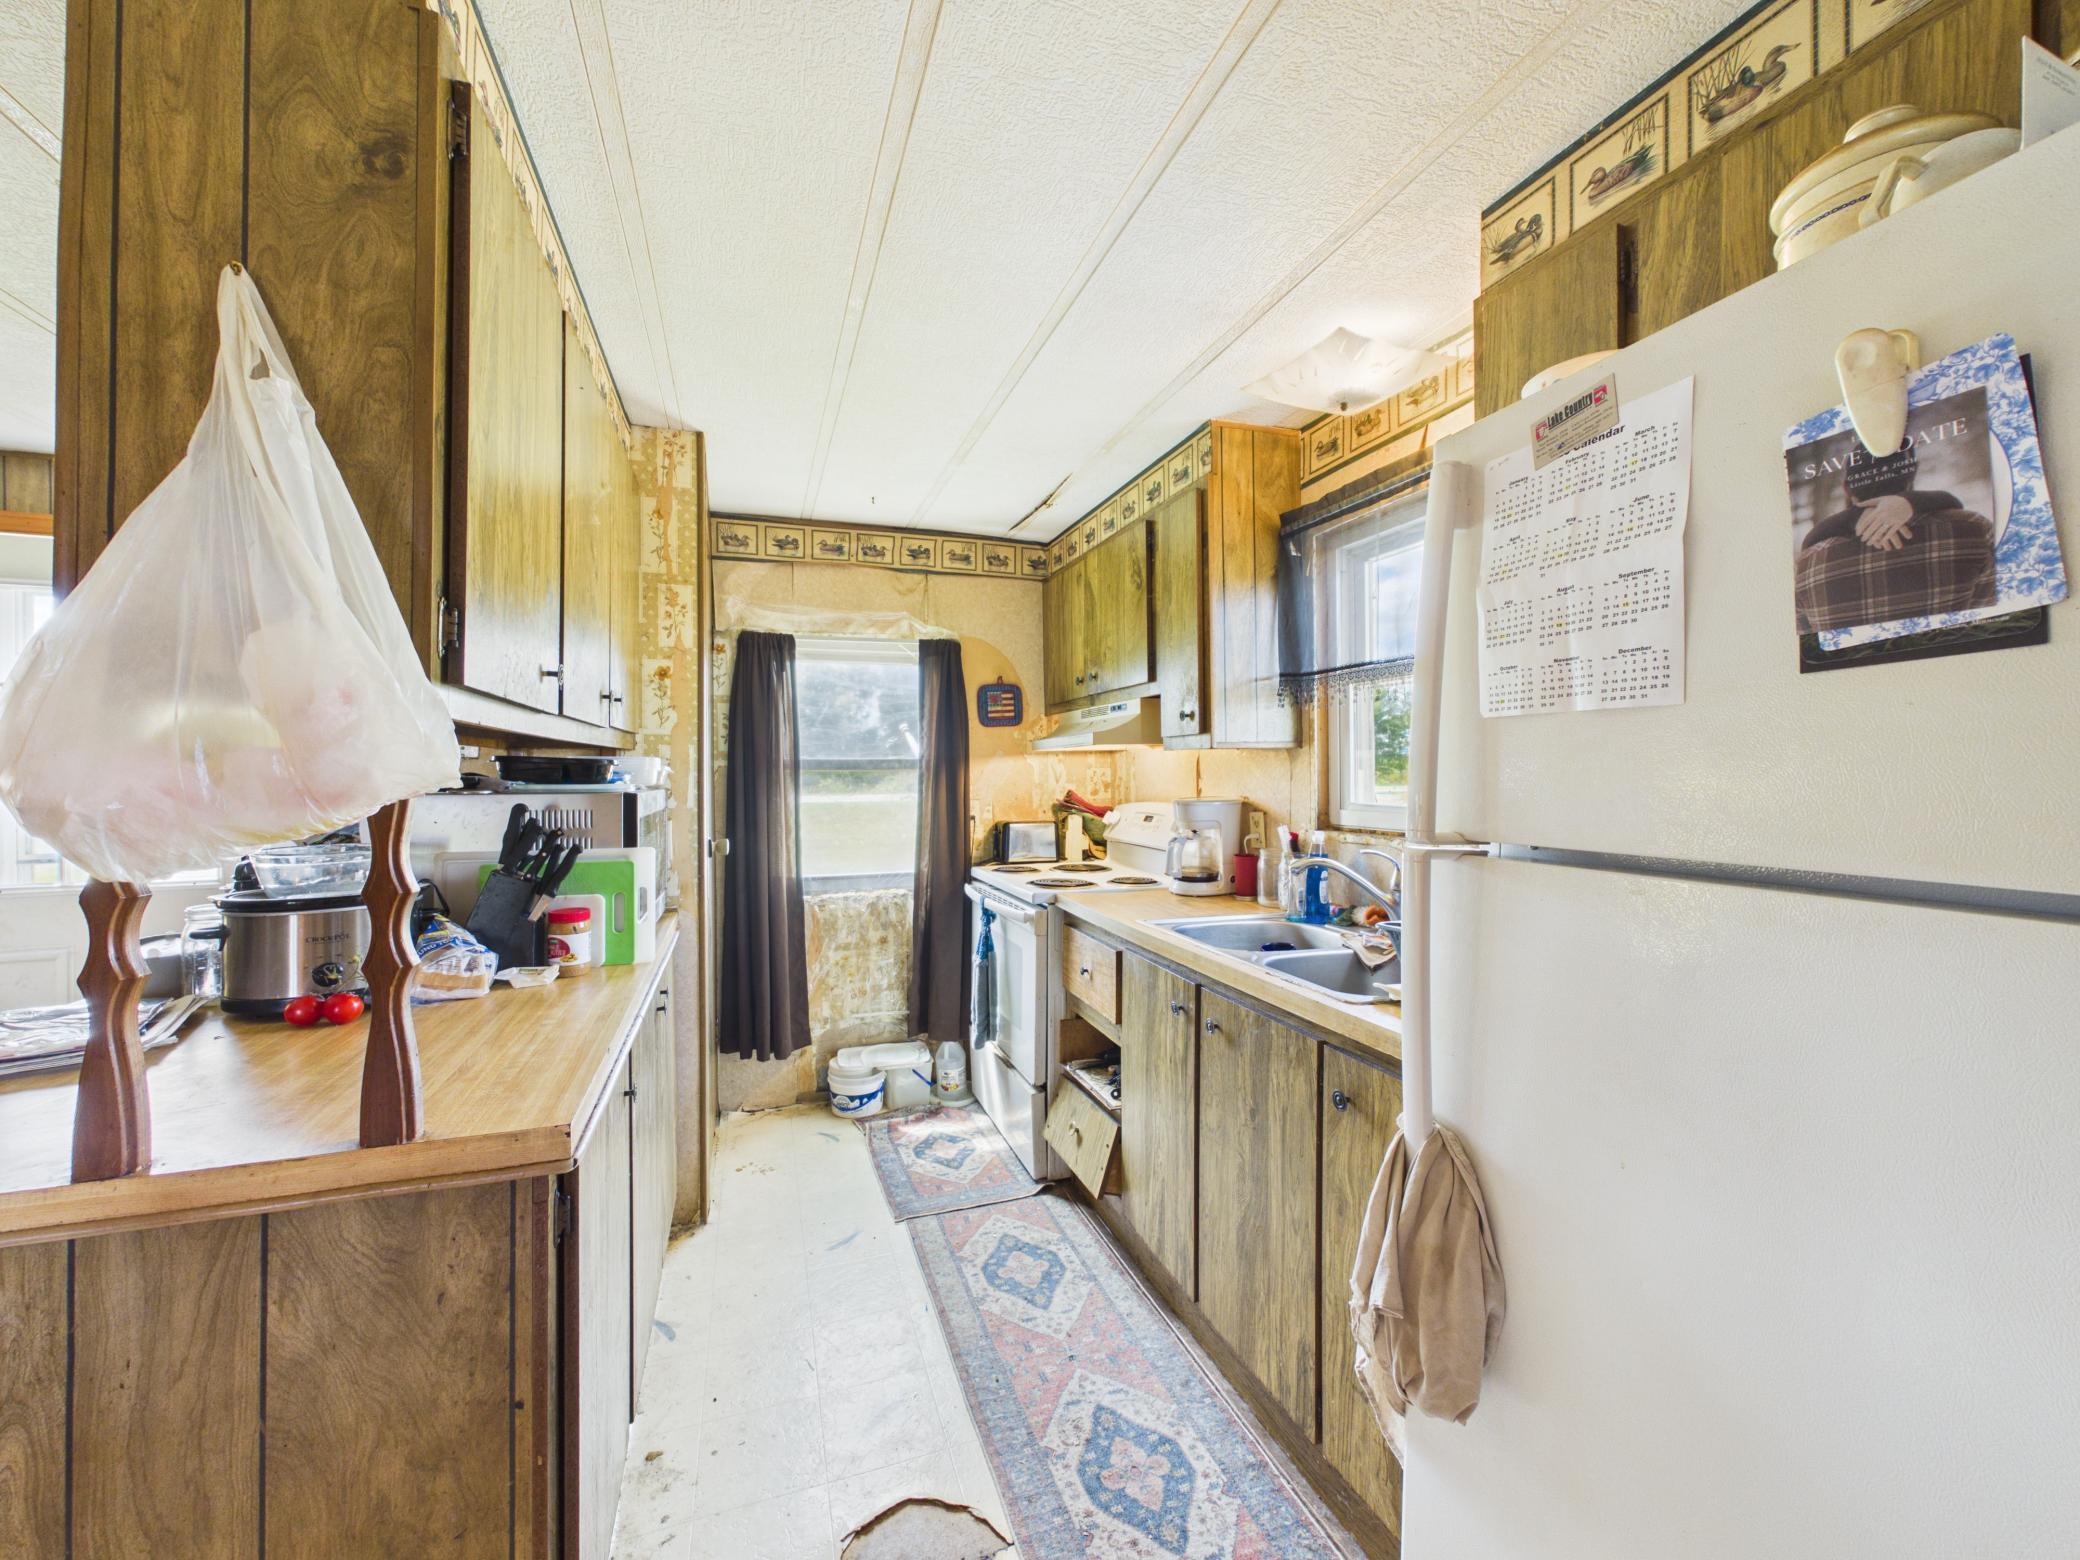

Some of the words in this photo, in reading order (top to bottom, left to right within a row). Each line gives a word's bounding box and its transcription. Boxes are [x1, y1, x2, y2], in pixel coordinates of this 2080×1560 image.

[1547, 410, 1564, 428] Lake
[1564, 391, 1593, 418] Country
[1634, 425, 1656, 437] March
[1803, 449, 1863, 480] SAVE
[1897, 417, 1968, 453] DATE
[1847, 467, 1878, 481] GRACE
[1849, 479, 1872, 489] Little
[1900, 466, 1915, 475] MN
[1632, 494, 1650, 502] June
[1618, 567, 1655, 580] September
[1618, 646, 1652, 654] December
